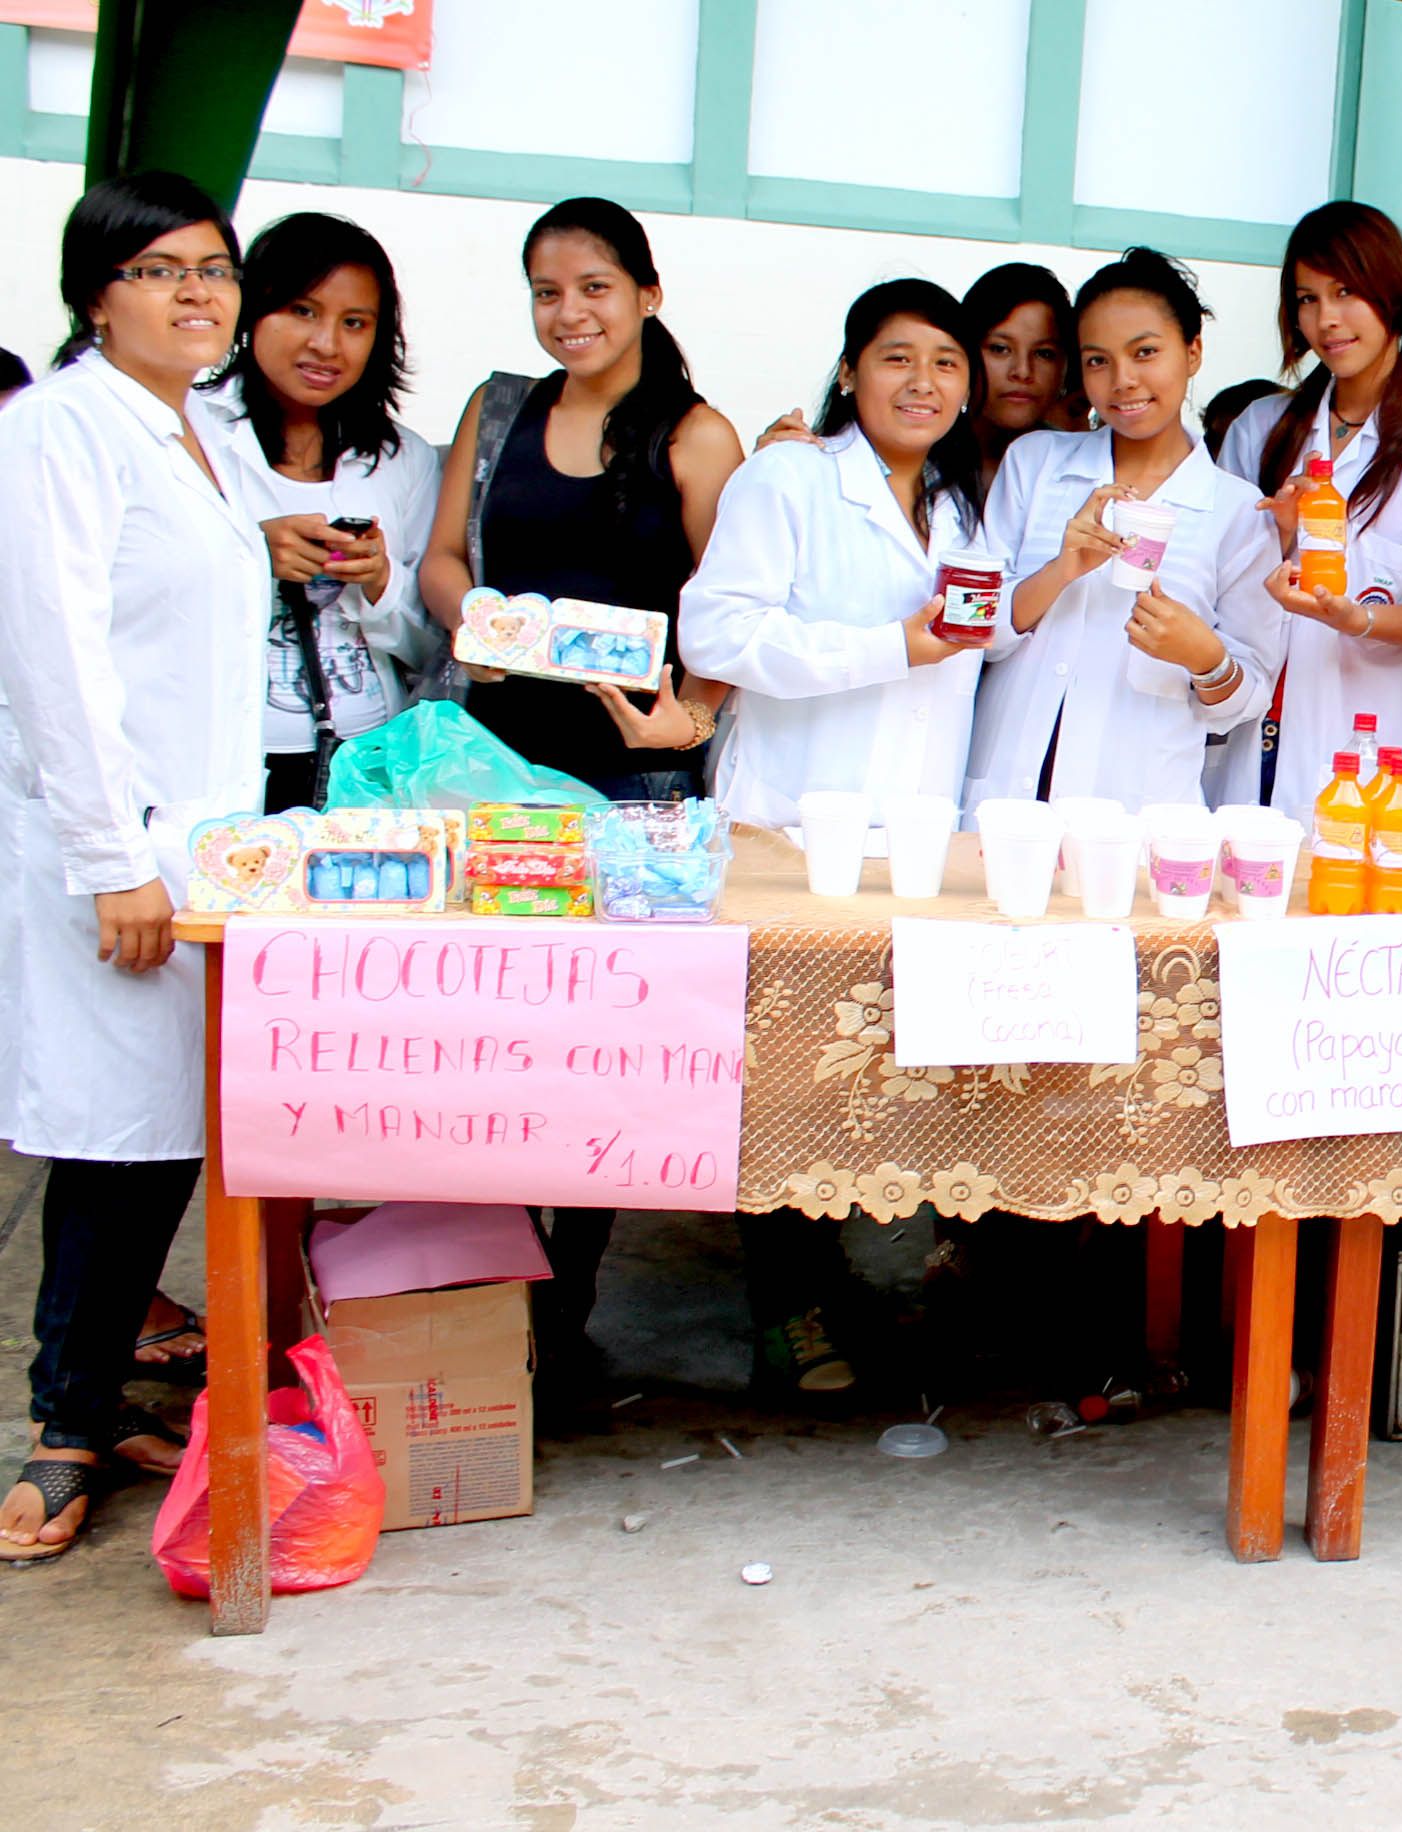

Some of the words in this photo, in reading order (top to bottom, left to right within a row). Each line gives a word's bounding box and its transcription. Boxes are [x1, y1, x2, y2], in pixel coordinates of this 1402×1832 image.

[252, 930, 649, 1008] CHOCOTEJAS
[265, 1018, 533, 1074] RELLENAS
[566, 1044, 643, 1078] CON
[282, 1102, 308, 1136] Y
[334, 1102, 547, 1146] MANJAR
[1266, 1090, 1315, 1117] con
